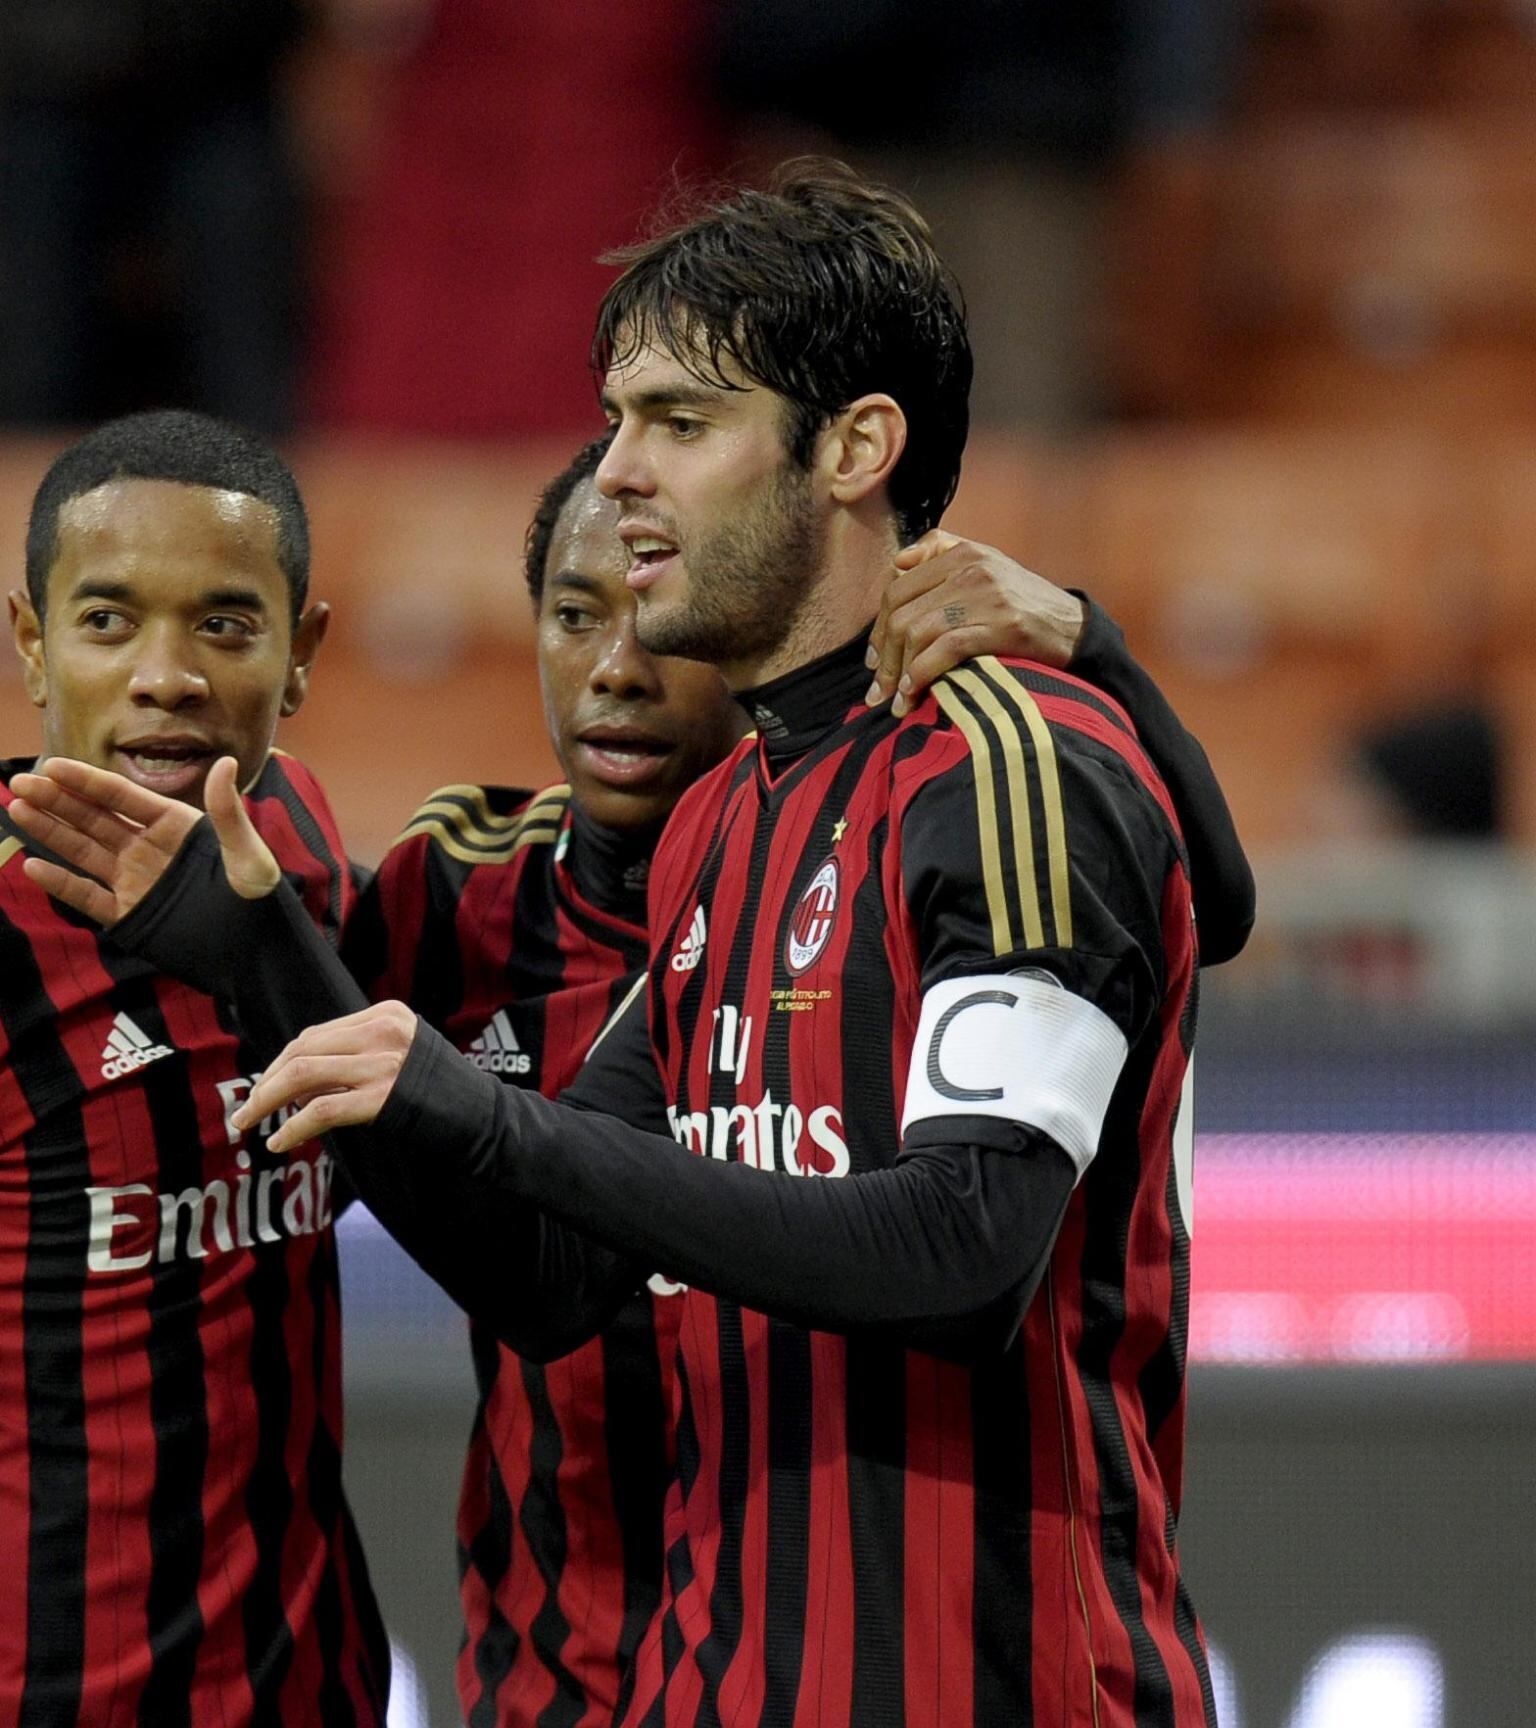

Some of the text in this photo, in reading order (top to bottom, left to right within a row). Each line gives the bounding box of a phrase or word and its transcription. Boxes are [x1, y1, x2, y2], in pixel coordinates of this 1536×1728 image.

[101, 1045, 175, 1080] adidas
[927, 990, 1019, 1101] C
[667, 1088, 851, 1179] mrates
[85, 1151, 334, 1272] Emirat
